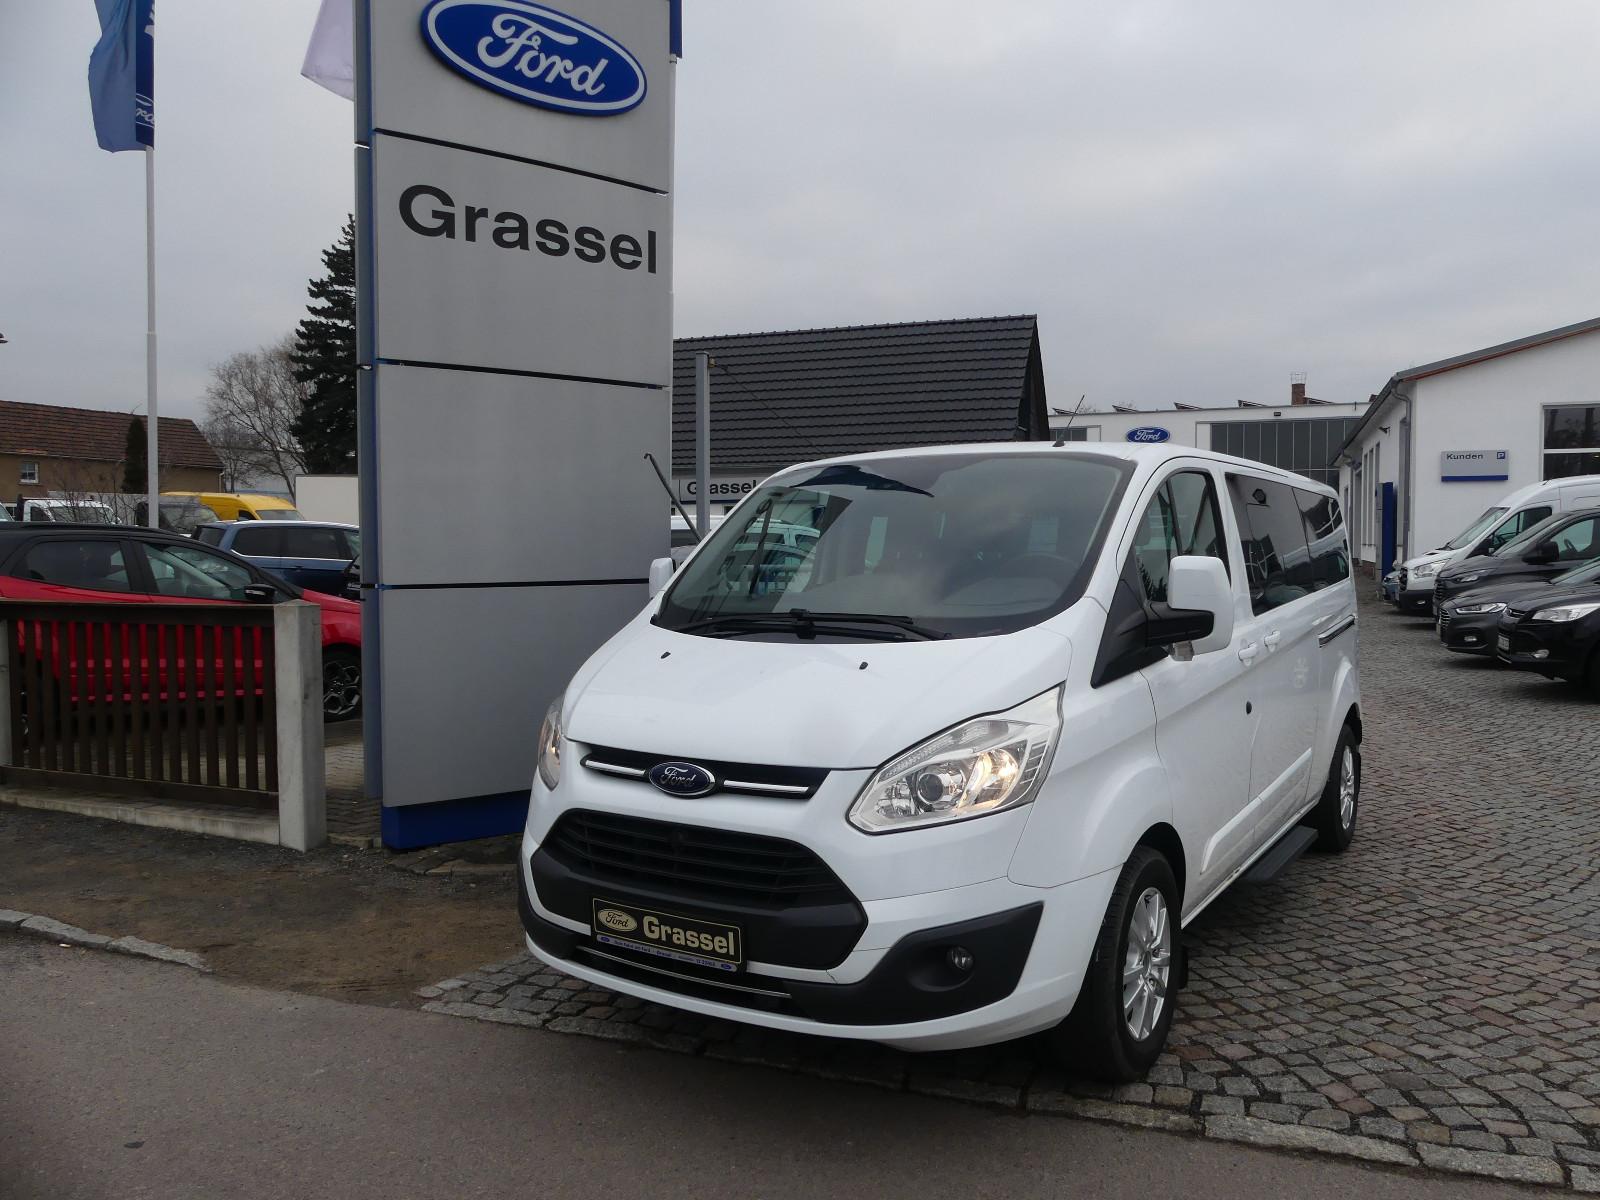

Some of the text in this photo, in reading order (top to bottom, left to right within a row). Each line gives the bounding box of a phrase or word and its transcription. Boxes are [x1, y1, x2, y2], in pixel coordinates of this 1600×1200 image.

[477, 13, 609, 96] Ford
[398, 184, 656, 274] Grassel
[1134, 429, 1161, 441] Ford
[686, 480, 757, 495] Gassel
[661, 766, 697, 787] Ford
[606, 911, 629, 928] Ford
[643, 915, 735, 956] Grassel
